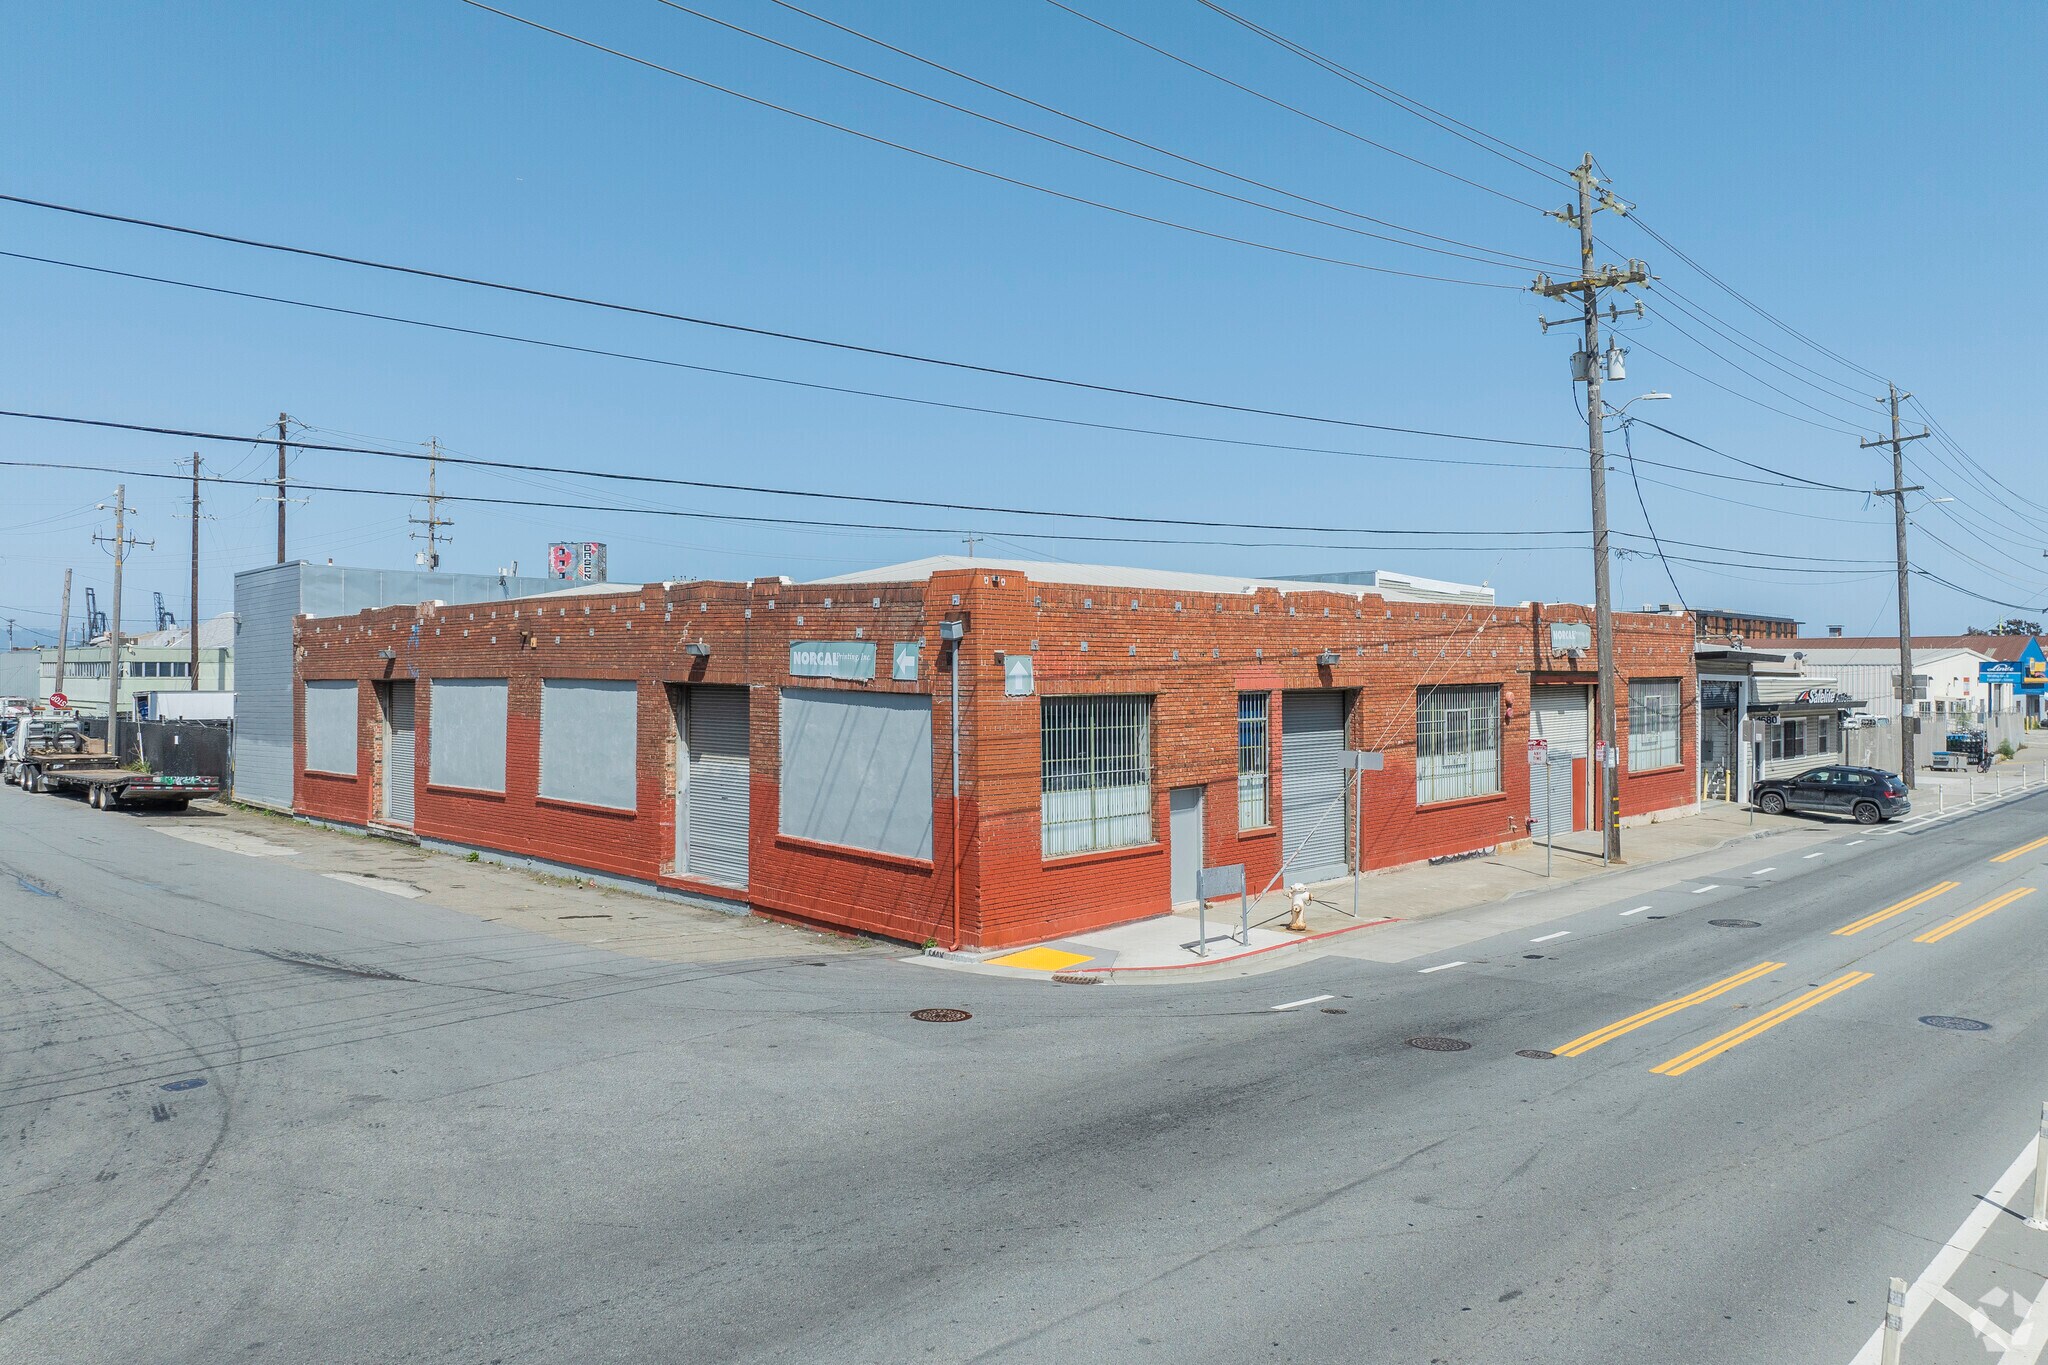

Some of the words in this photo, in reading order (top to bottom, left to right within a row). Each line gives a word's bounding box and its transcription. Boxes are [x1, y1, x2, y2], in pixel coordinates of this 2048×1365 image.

[793, 651, 839, 666] NORCAL
[1987, 663, 2014, 672] Linde
[50, 695, 67, 707] STOP
[1809, 689, 1835, 704] Safelite
